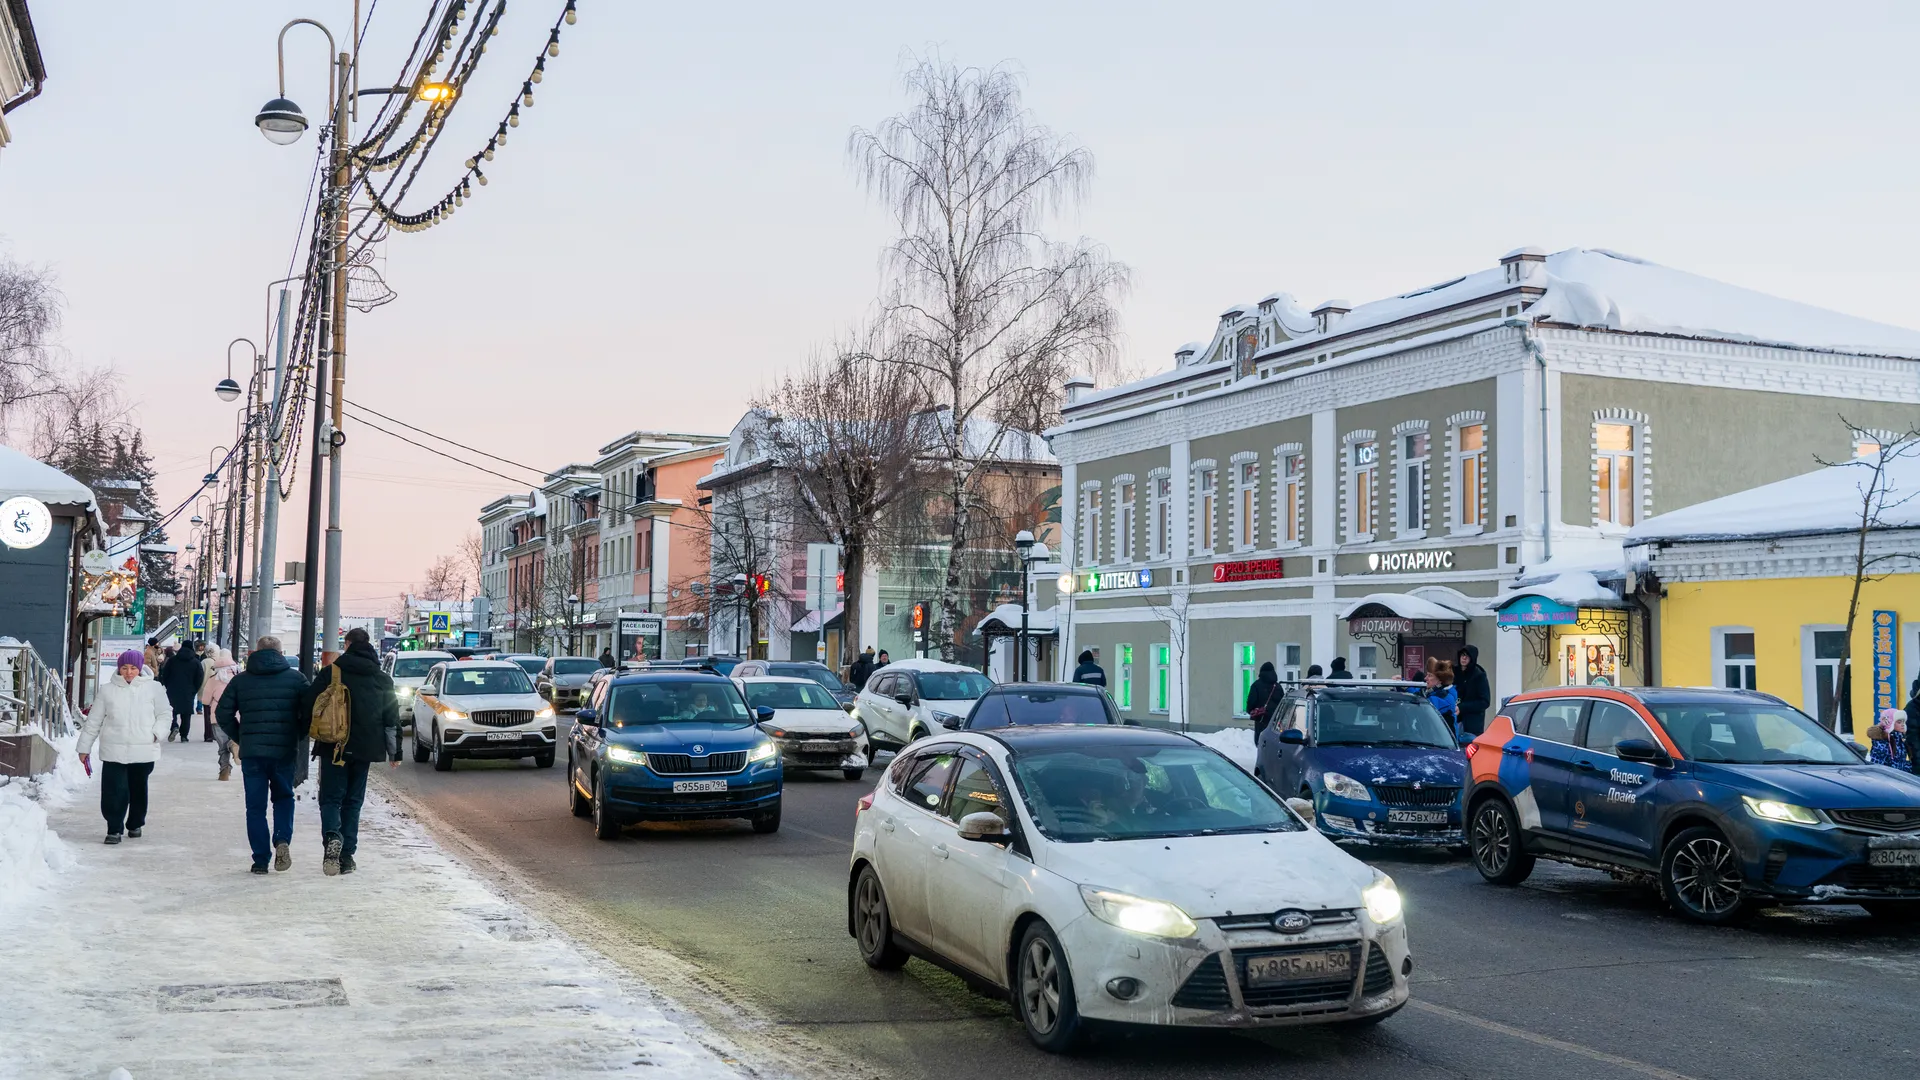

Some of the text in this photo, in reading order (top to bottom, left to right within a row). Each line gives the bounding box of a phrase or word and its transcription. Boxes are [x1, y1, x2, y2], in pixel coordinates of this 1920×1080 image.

[1382, 550, 1453, 571] НОТАРИУС
[1099, 571, 1138, 589] АПТЕКА
[1361, 620, 1410, 632] НОТАРИУС
[1610, 768, 1644, 785] Яндекс
[1607, 787, 1636, 804] Драйв
[1283, 917, 1303, 927] Ford
